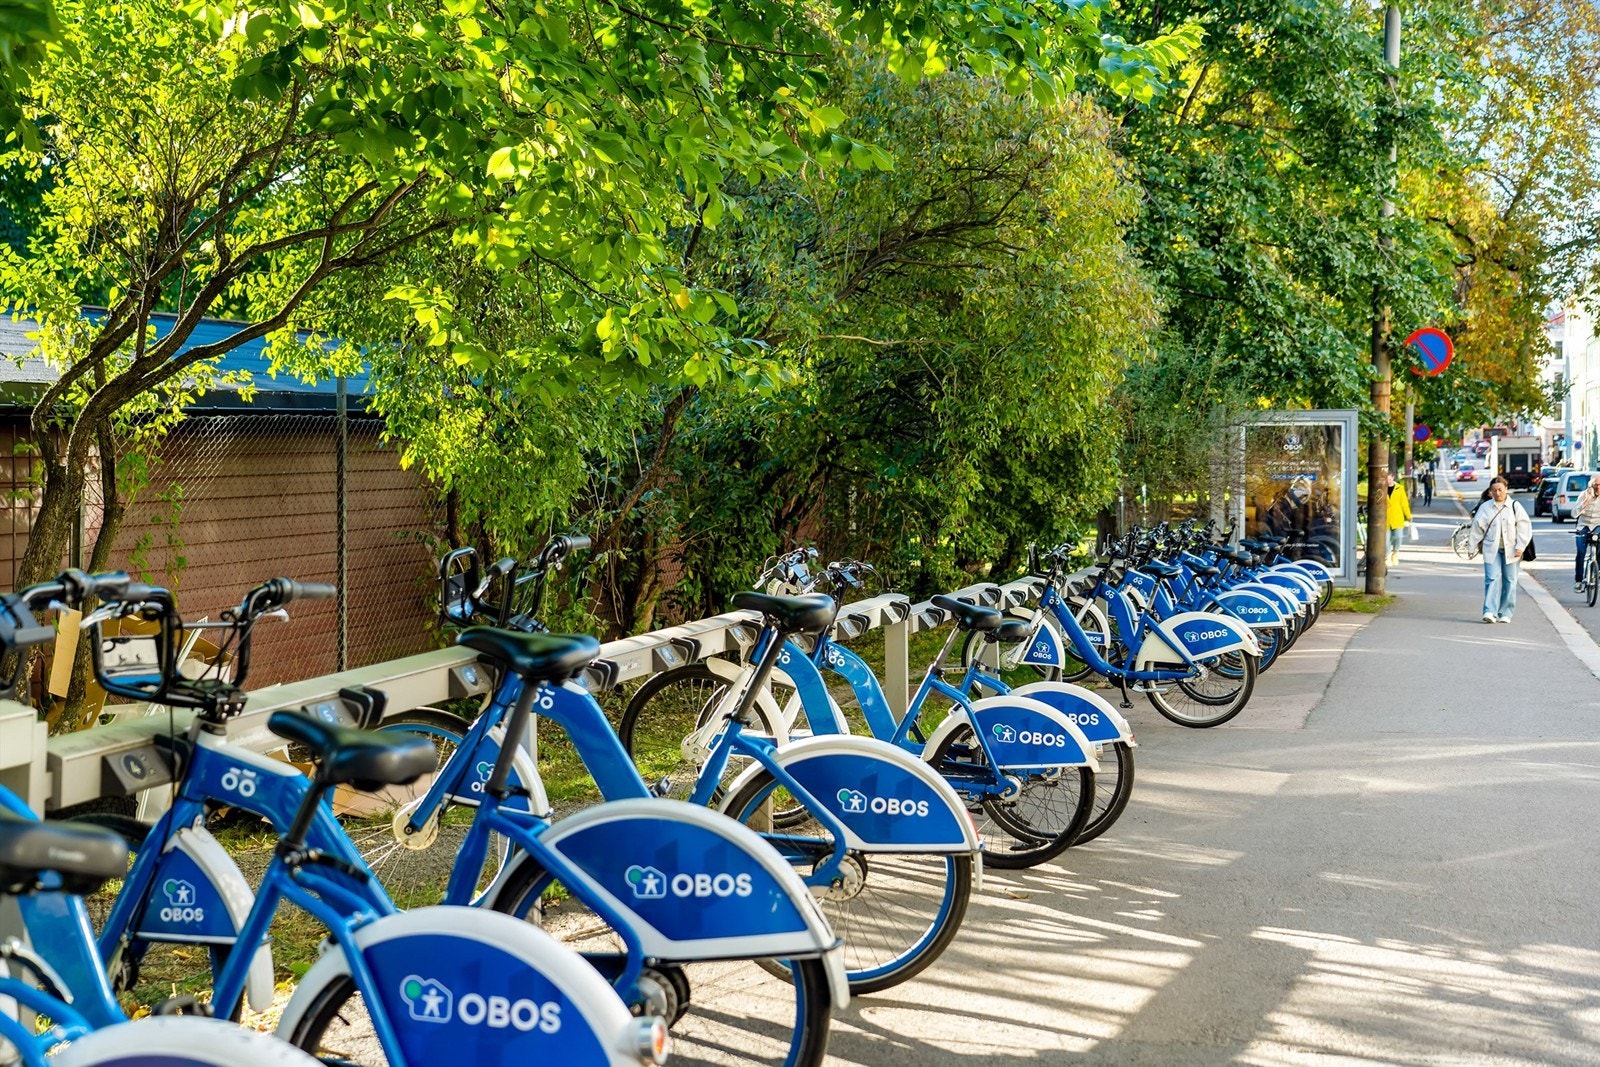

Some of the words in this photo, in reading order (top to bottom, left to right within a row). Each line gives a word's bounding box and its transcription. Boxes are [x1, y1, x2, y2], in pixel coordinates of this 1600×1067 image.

[1200, 629, 1228, 640] OBOS
[1032, 651, 1052, 660] OBOS
[1068, 713, 1099, 726] BOS
[1019, 731, 1066, 747] OBOS
[870, 797, 929, 817] OBOS
[671, 872, 753, 898] OBOS
[160, 907, 205, 922] OBOS
[457, 992, 562, 1034] OBOS
